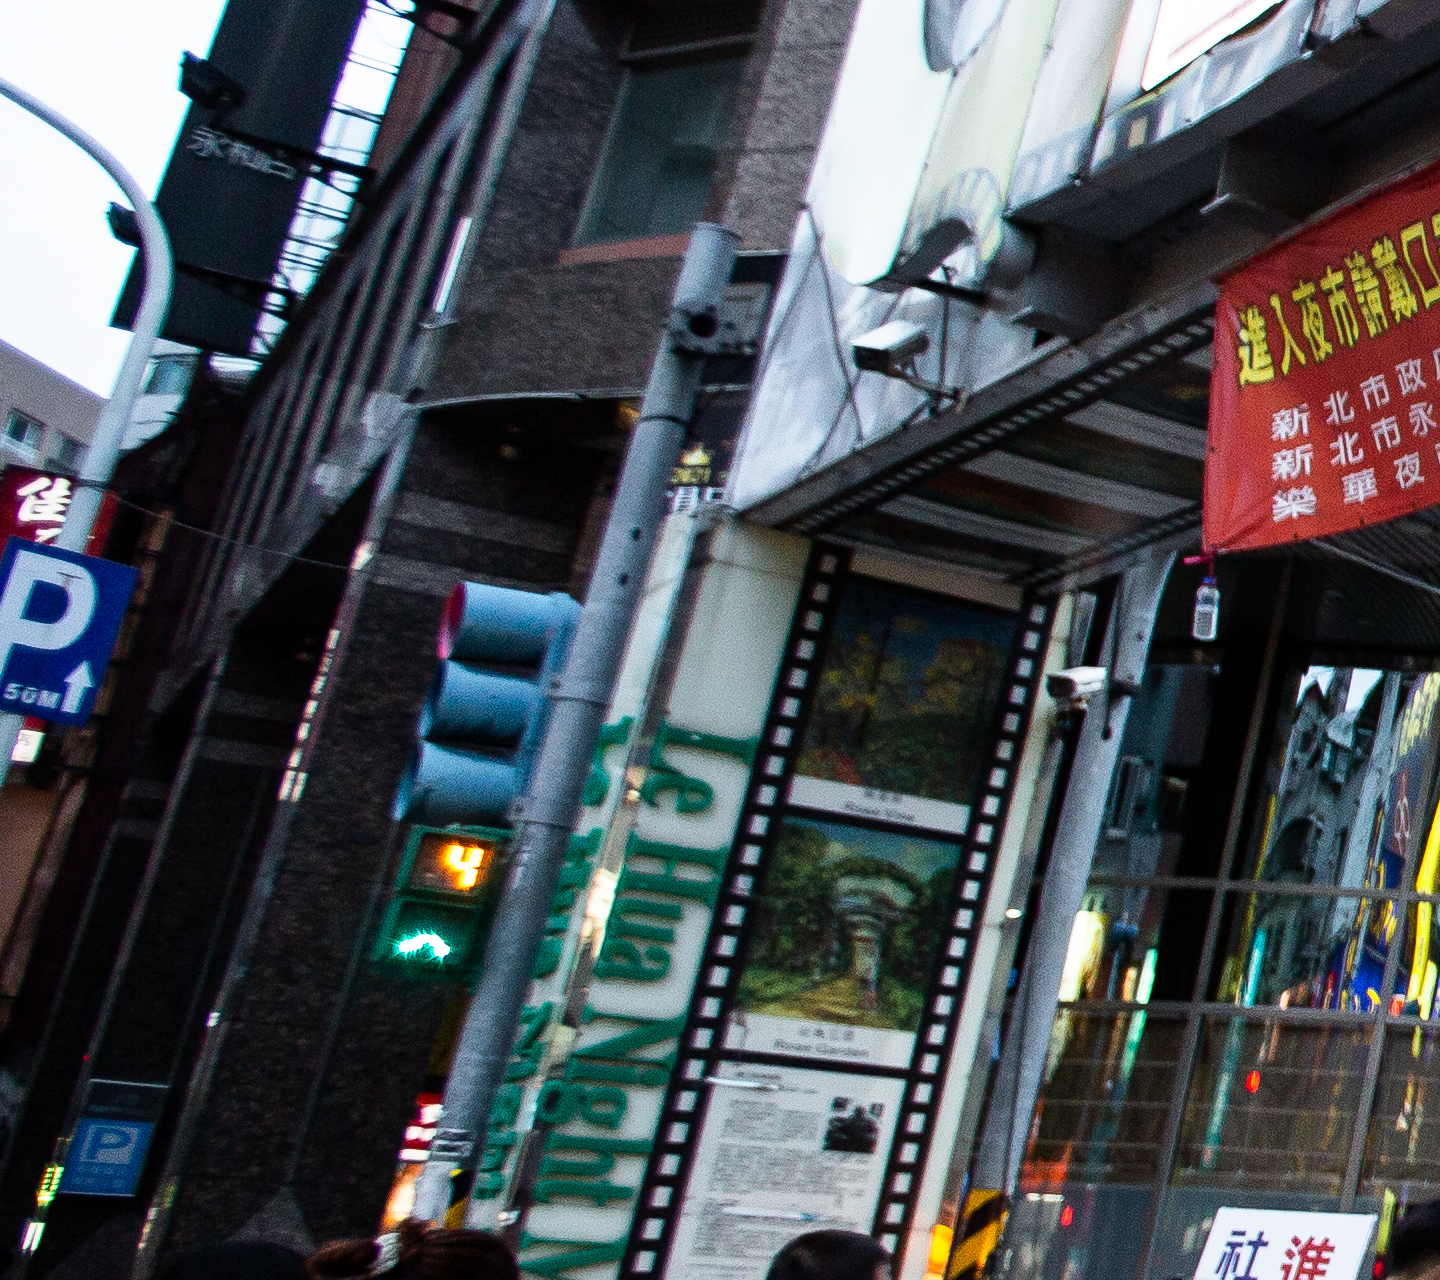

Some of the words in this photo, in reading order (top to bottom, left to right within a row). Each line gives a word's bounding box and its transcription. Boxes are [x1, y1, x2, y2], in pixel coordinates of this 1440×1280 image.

[0, 549, 98, 651] P
[640, 722, 756, 818] Le
[442, 842, 490, 891] 4
[594, 835, 729, 982] Hua
[534, 1001, 692, 1210] Night
